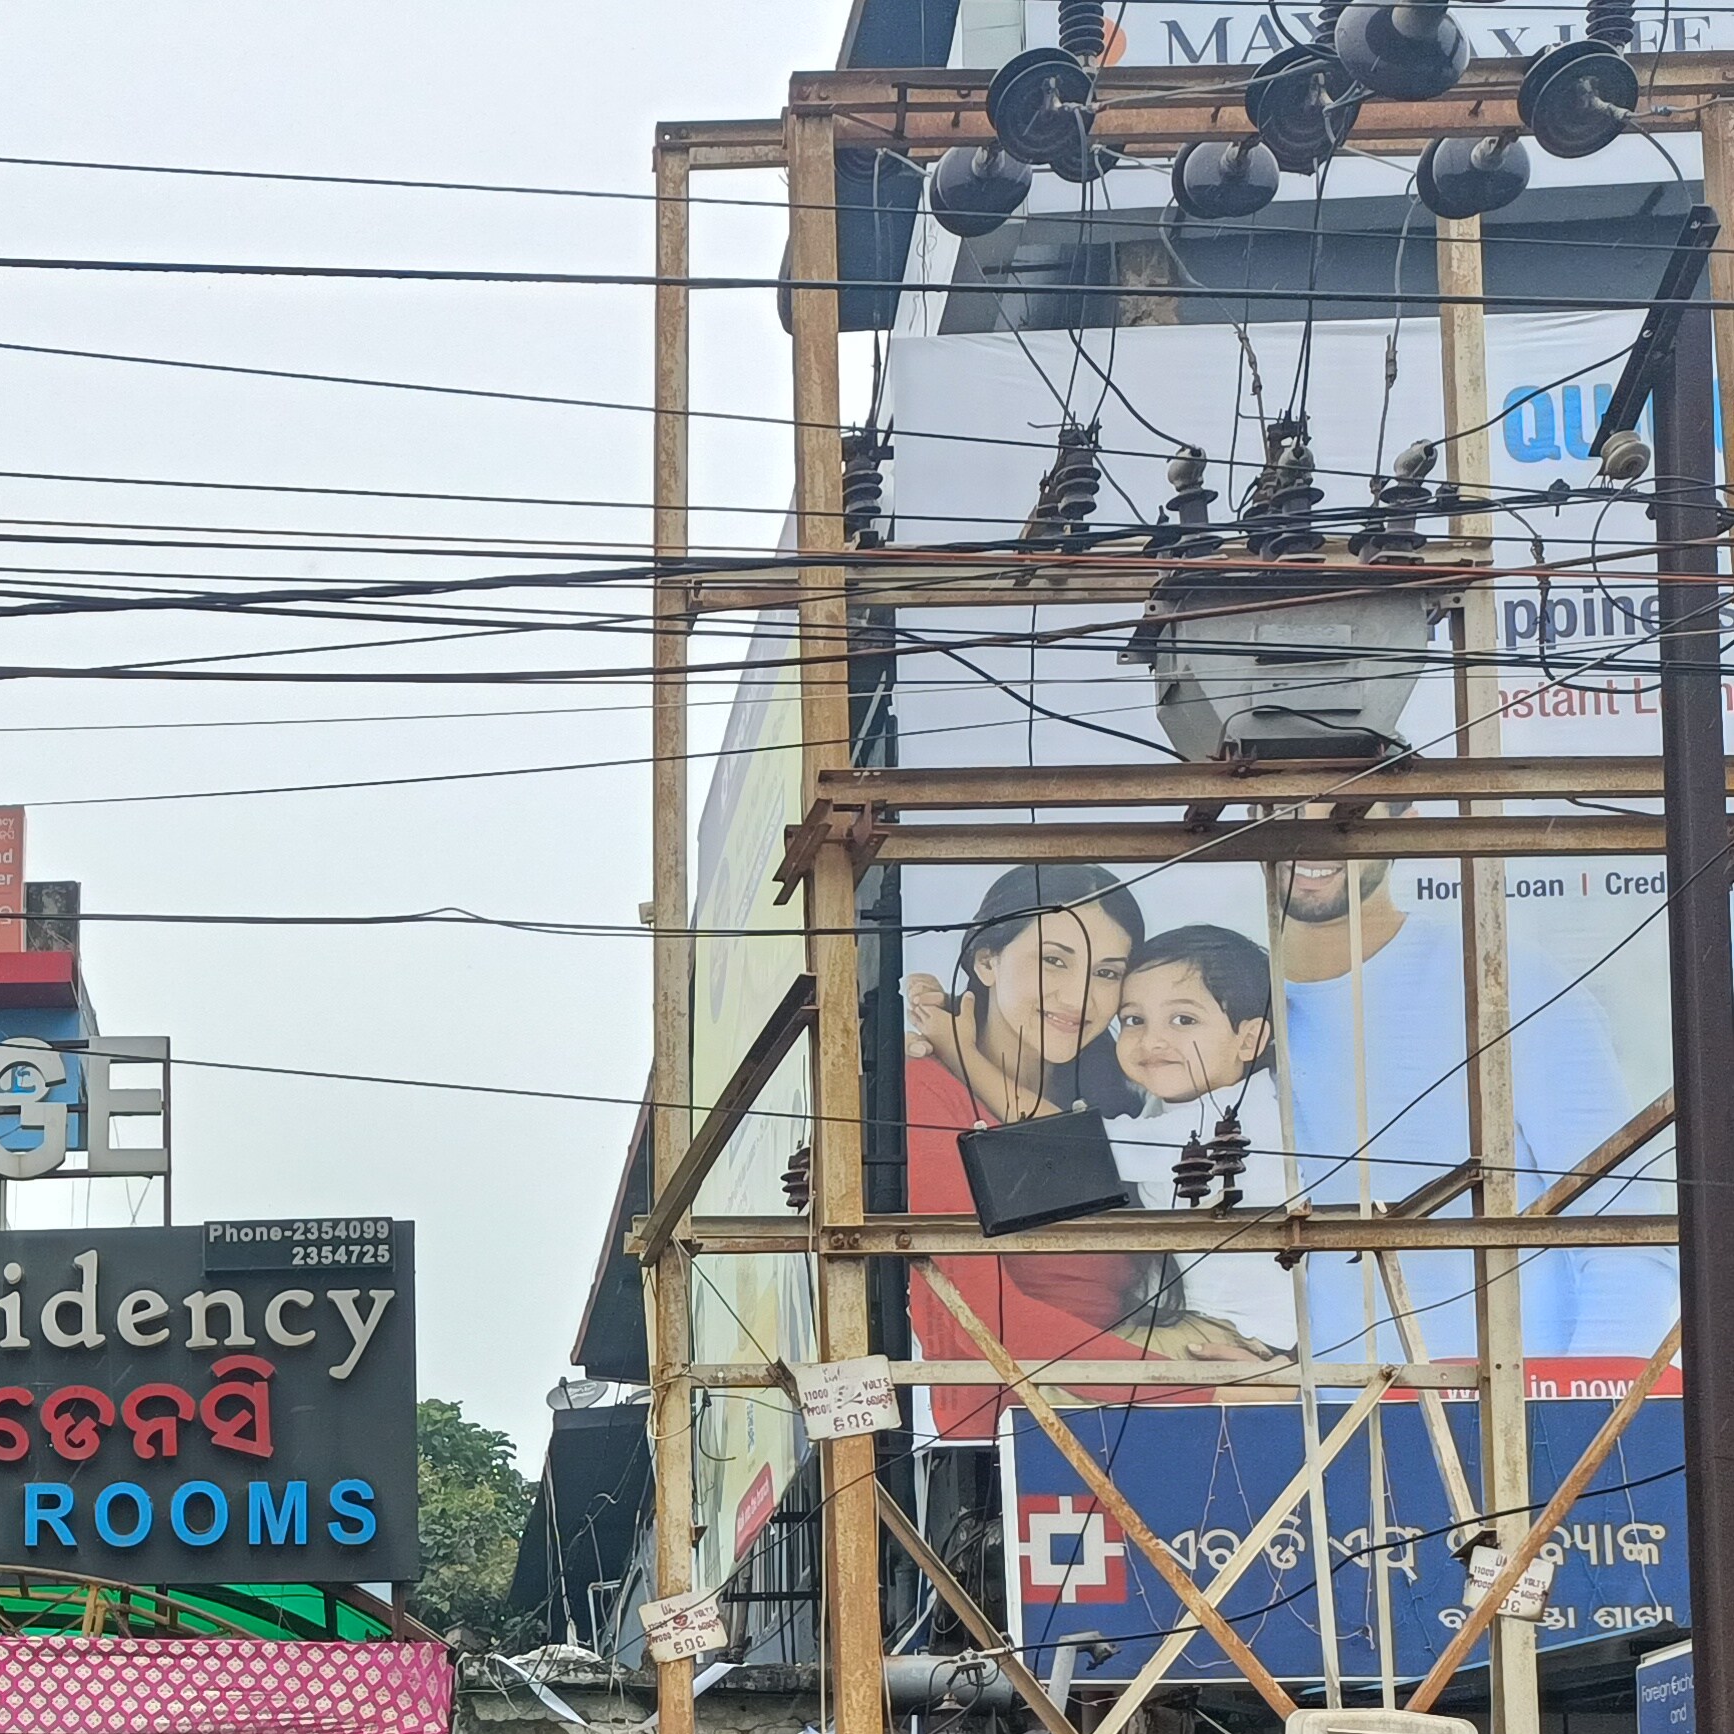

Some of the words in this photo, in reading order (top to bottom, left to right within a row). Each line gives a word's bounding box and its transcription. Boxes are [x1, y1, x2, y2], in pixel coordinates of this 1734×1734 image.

[209, 1220, 391, 1243] Phone-2354099
[291, 1245, 391, 1265] 2354725
[862, 1377, 890, 1391] VOLTS
[1530, 1375, 1558, 1399] in
[23, 1480, 378, 1548] ROOMS
[1642, 1677, 1672, 1703] Foreign
[1670, 1703, 1687, 1725] and
